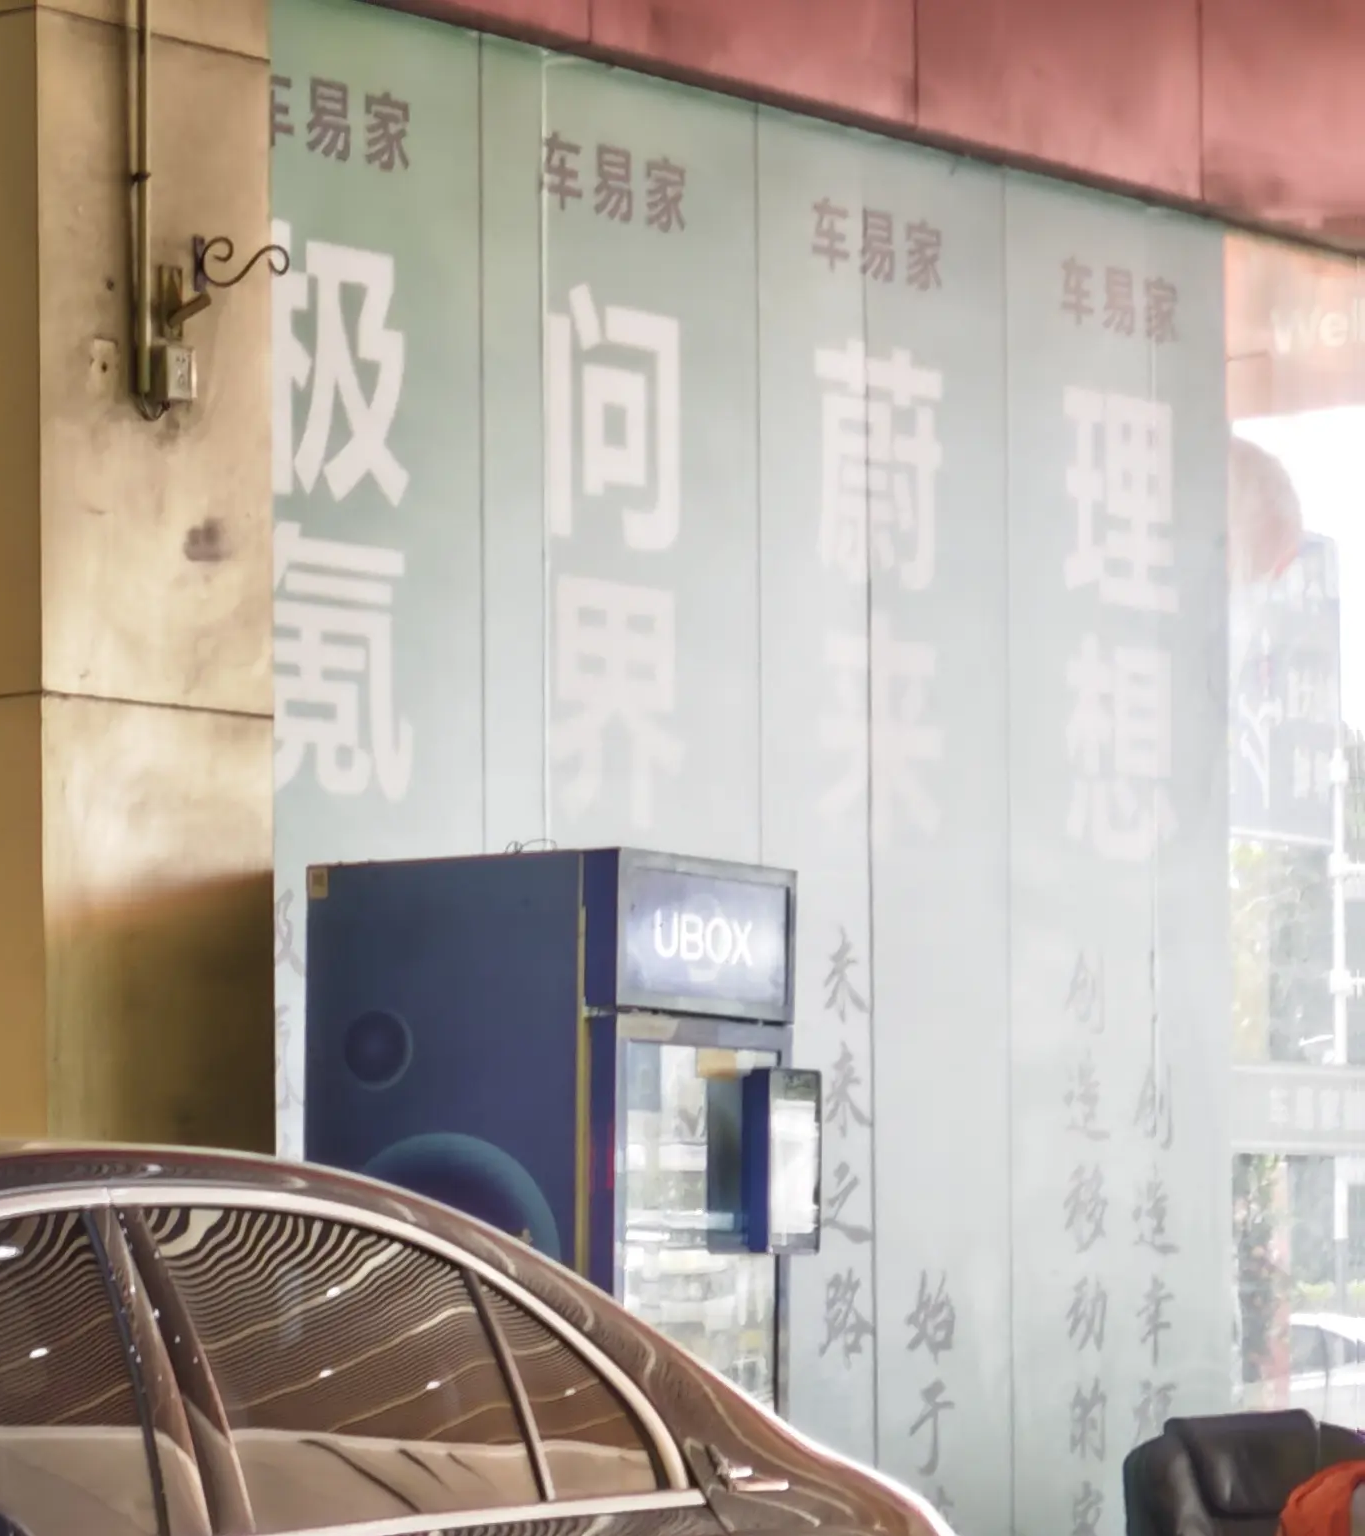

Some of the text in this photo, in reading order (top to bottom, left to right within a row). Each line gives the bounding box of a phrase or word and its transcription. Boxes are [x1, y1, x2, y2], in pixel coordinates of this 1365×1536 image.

[542, 131, 688, 234] 车易家
[810, 196, 945, 292] 车易家
[1060, 257, 1180, 346] 车易家
[271, 218, 413, 800] 极氪
[546, 283, 684, 832] 问界
[813, 341, 946, 836] 蔚来
[1062, 383, 1181, 864] 理想
[654, 908, 754, 967] UBOX
[822, 927, 875, 1373] 未来之路
[903, 1266, 959, 1525] 始于
